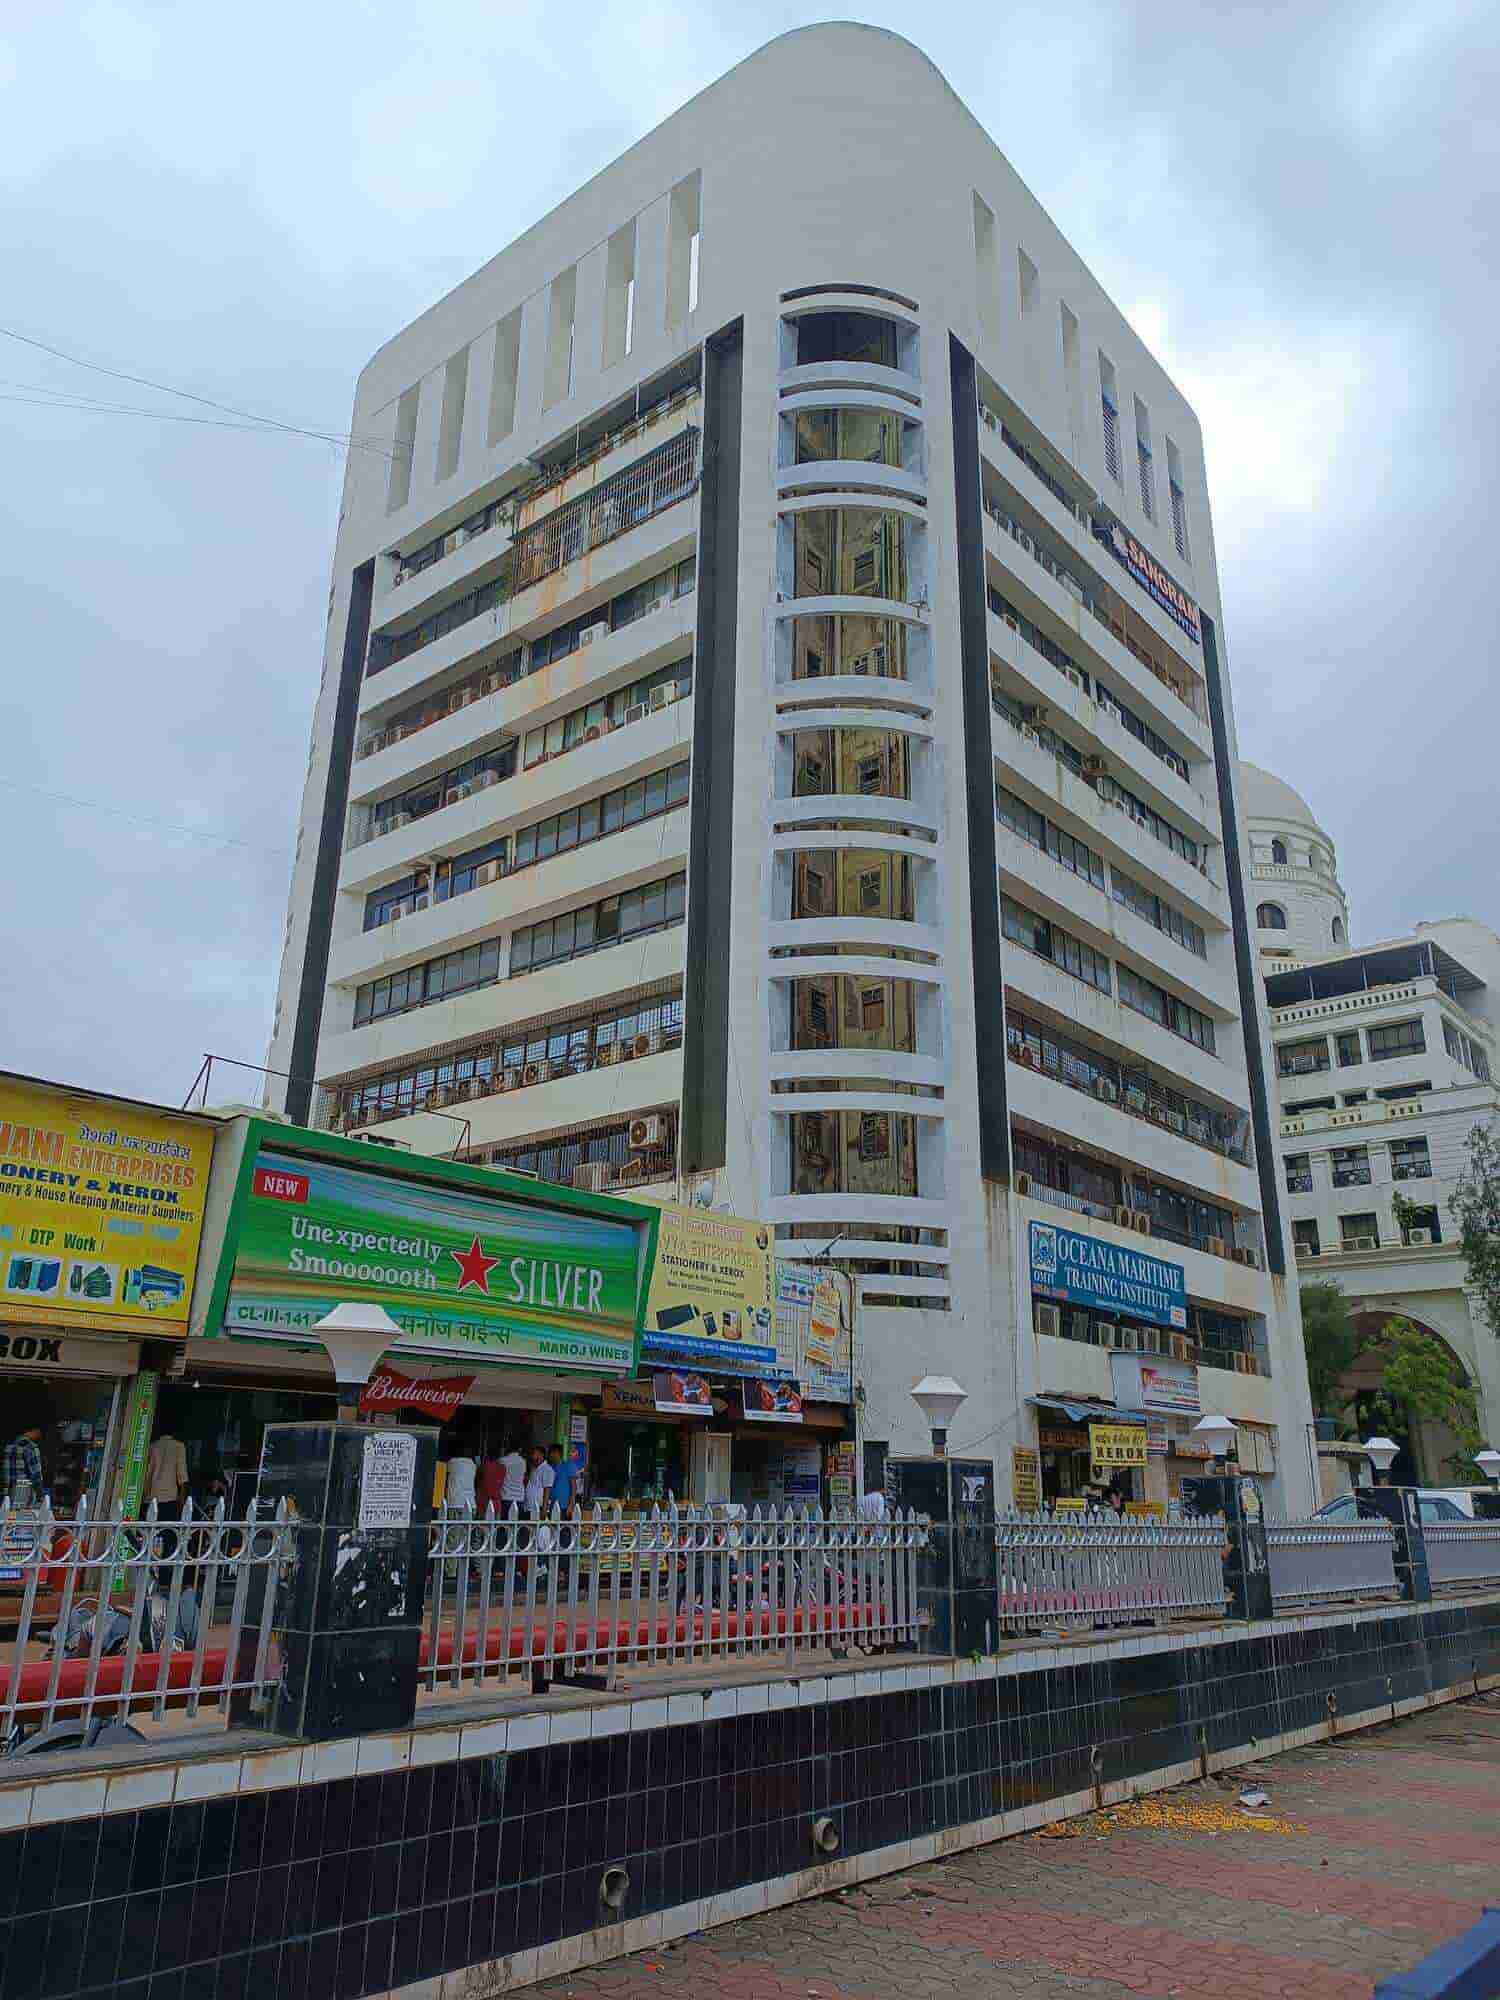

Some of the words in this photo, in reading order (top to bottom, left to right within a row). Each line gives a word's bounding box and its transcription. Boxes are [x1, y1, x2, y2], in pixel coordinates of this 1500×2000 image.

[1127, 539, 1200, 631] SANGRAM
[67, 1144, 196, 1188] ENTERPRISES
[107, 1179, 179, 1204] XEROX
[263, 1175, 299, 1197] NEW
[35, 1185, 66, 1203] House
[68, 1190, 108, 1210] Keeping
[109, 1197, 150, 1216] Material
[152, 1204, 195, 1223] Suppliers
[29, 1228, 55, 1246] DTP
[64, 1232, 97, 1252] Work
[291, 1215, 442, 1264] Unexpectedly
[661, 1253, 710, 1271] STATIONERY
[1057, 1234, 1115, 1273] OCEANA
[1117, 1251, 1180, 1290] MARITIME
[508, 1255, 604, 1313] SILVER
[1064, 1265, 1118, 1297] TRAINING
[1119, 1280, 1171, 1311] INSTITUTE
[538, 1340, 586, 1357] MANOJ
[588, 1345, 630, 1361] WINES
[365, 1374, 465, 1406] Budweiser
[1095, 1445, 1144, 1459] XEROX
